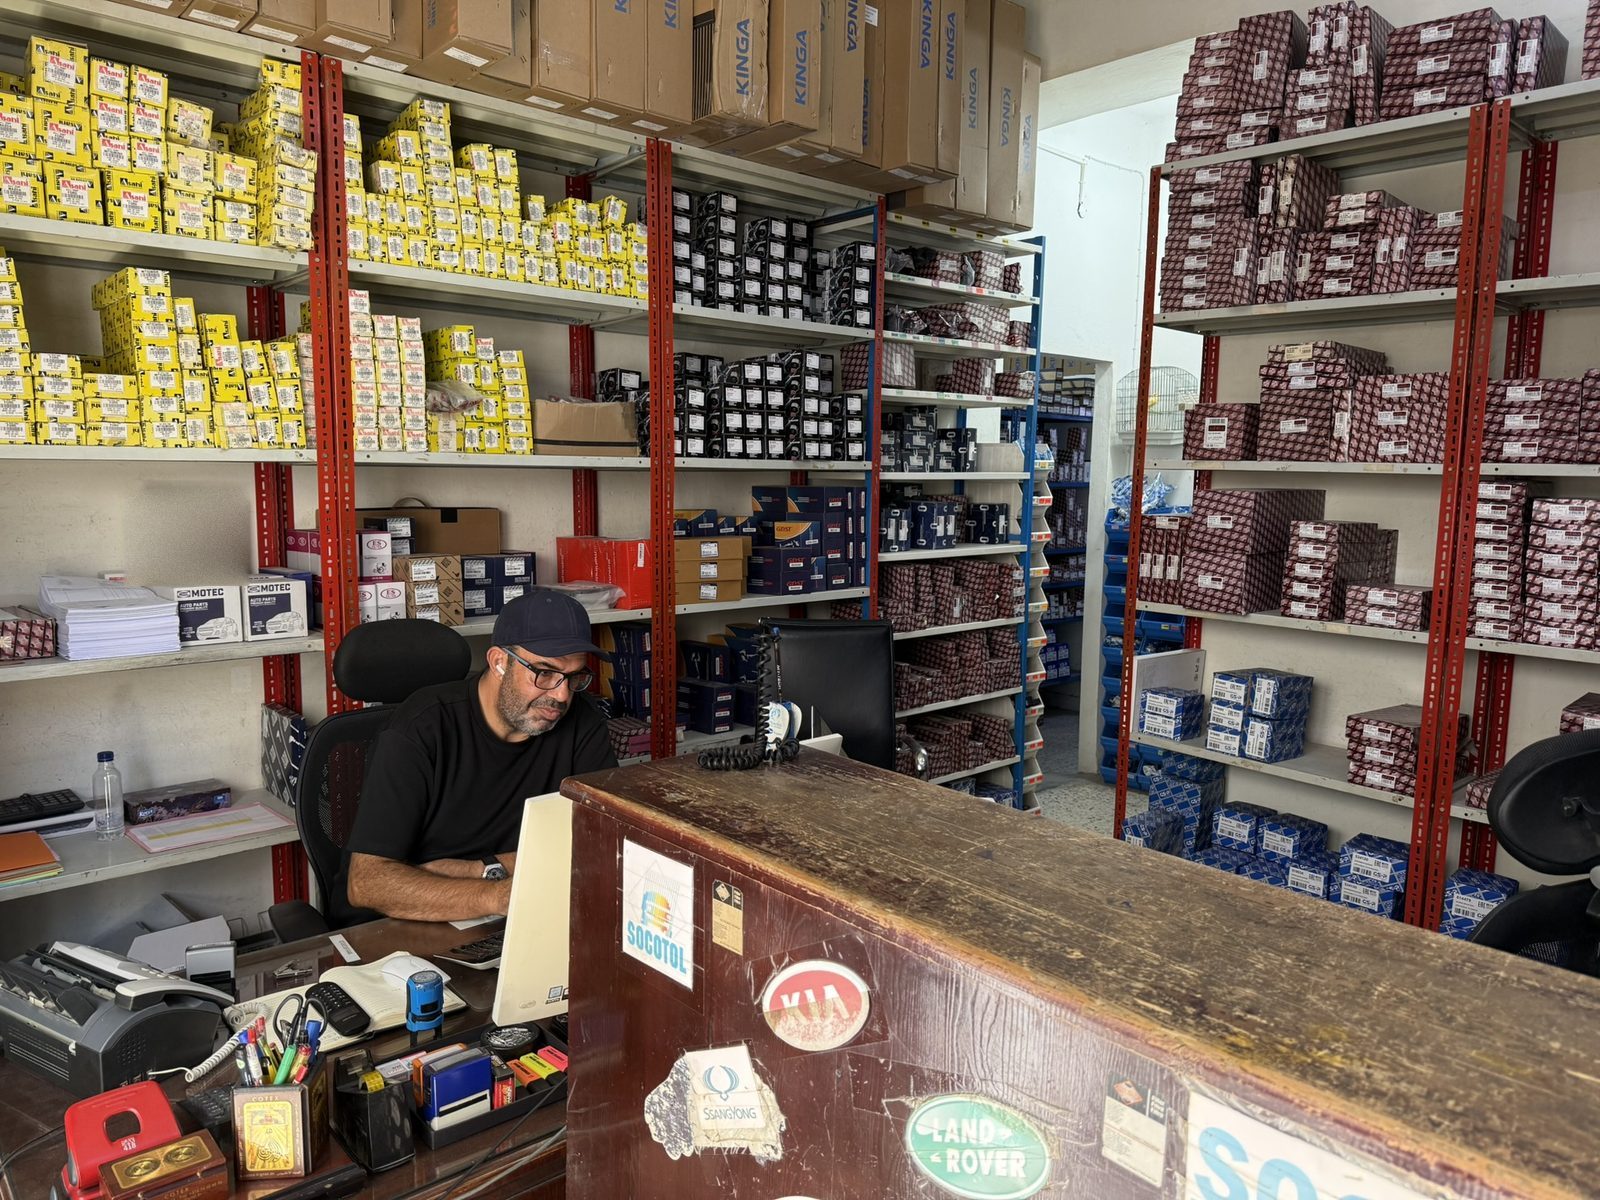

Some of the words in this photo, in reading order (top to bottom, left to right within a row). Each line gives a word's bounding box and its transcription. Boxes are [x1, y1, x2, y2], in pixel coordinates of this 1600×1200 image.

[847, 0, 858, 51] NGA
[946, 12, 956, 80] KINGA
[736, 18, 751, 95] KINGA
[794, 30, 808, 105] KINGA
[968, 67, 978, 129] KINGA
[1000, 87, 1011, 147] KINGA
[191, 588, 224, 598] MOTEC
[261, 583, 291, 592] MOTEC
[627, 920, 687, 974] SOCOTOL
[780, 984, 849, 1025] KIA
[932, 1118, 996, 1145] LAND
[946, 1148, 1027, 1178] ROVER
[1193, 1127, 1376, 1200] SO
